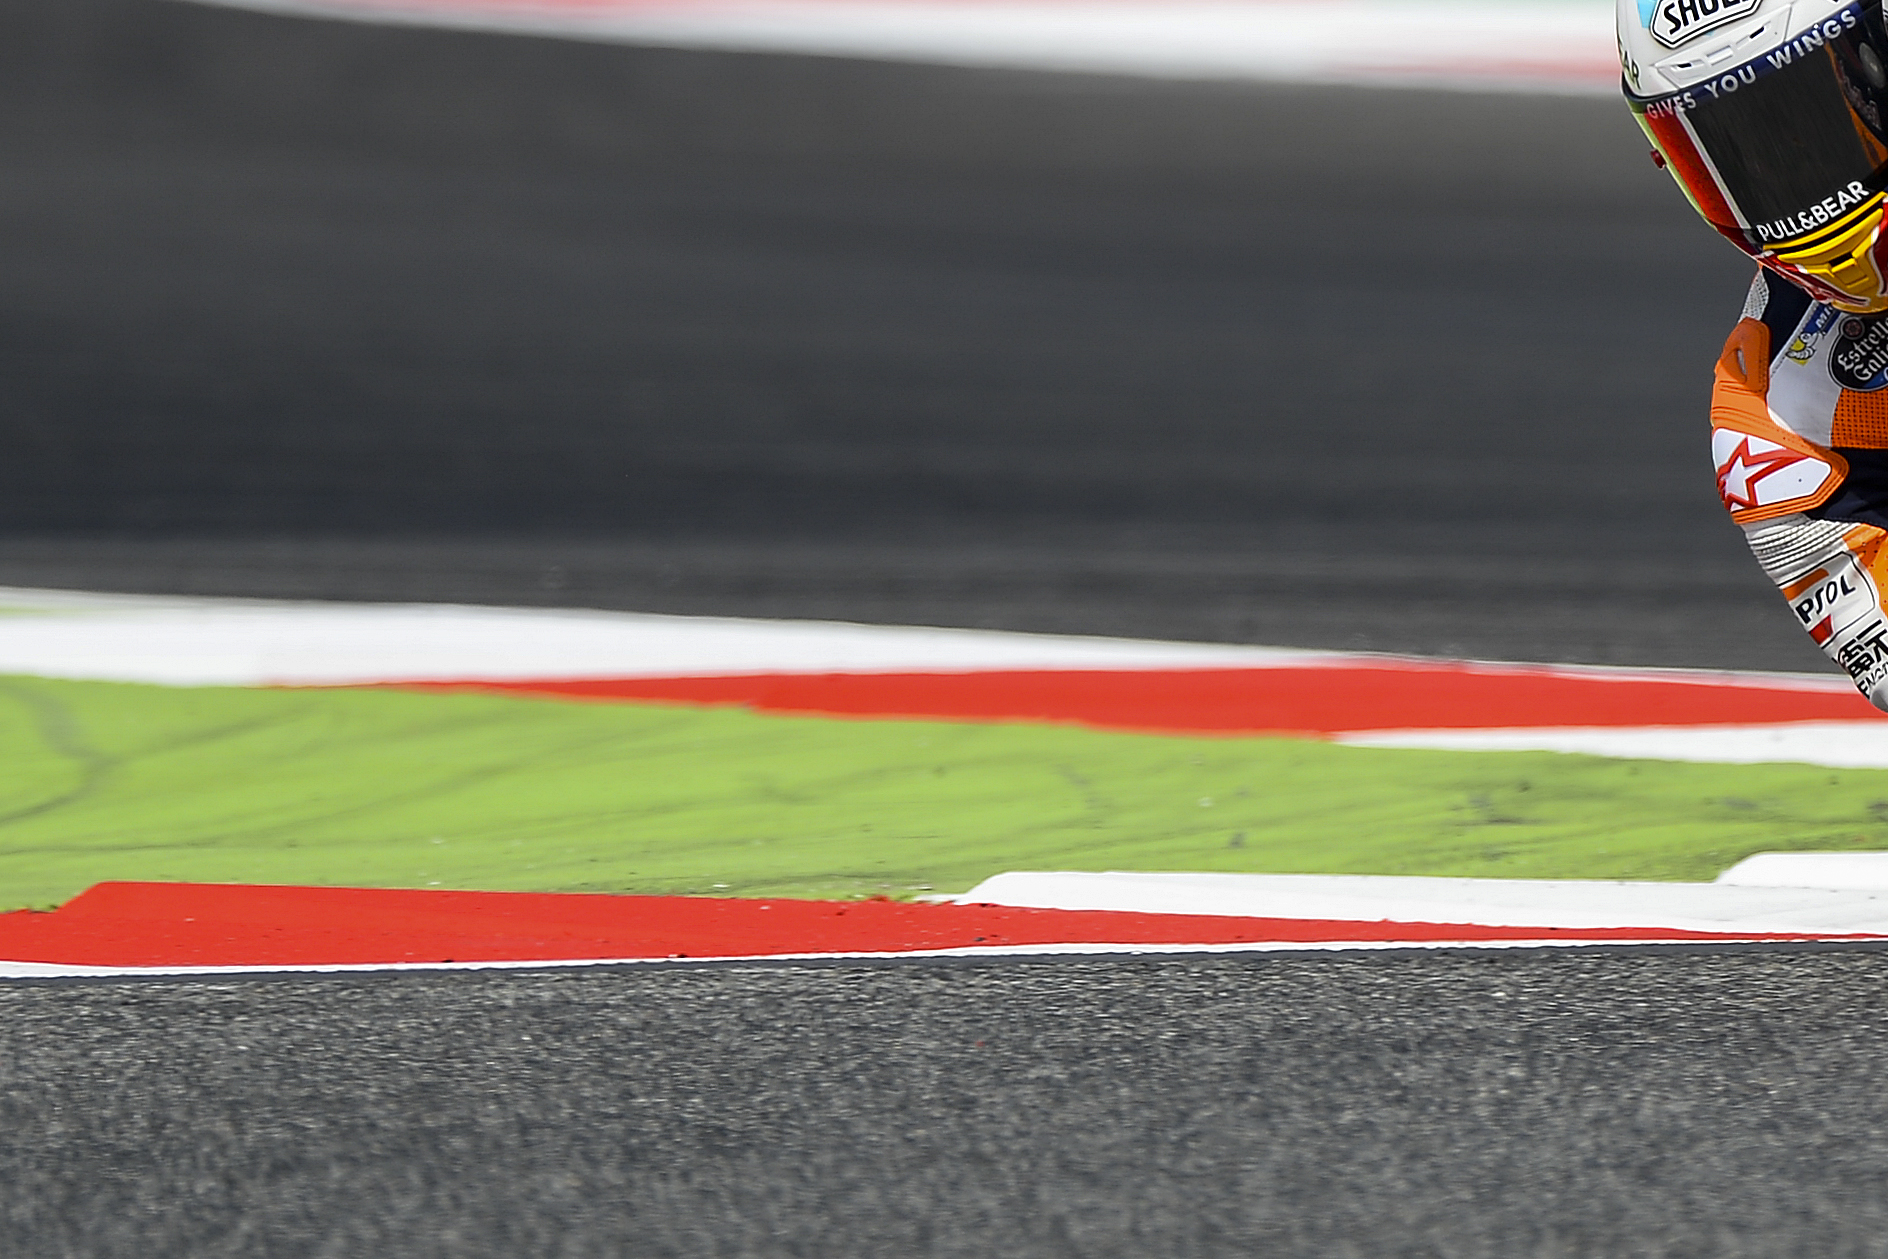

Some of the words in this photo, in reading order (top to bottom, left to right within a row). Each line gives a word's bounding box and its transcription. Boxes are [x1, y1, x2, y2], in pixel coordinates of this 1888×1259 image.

[1646, 92, 1697, 120] GIVES
[1704, 65, 1757, 99] YOU
[1766, 9, 1856, 70] WINGS
[1756, 180, 1870, 242] PULL&BEAR
[1796, 575, 1856, 624] PSOL
